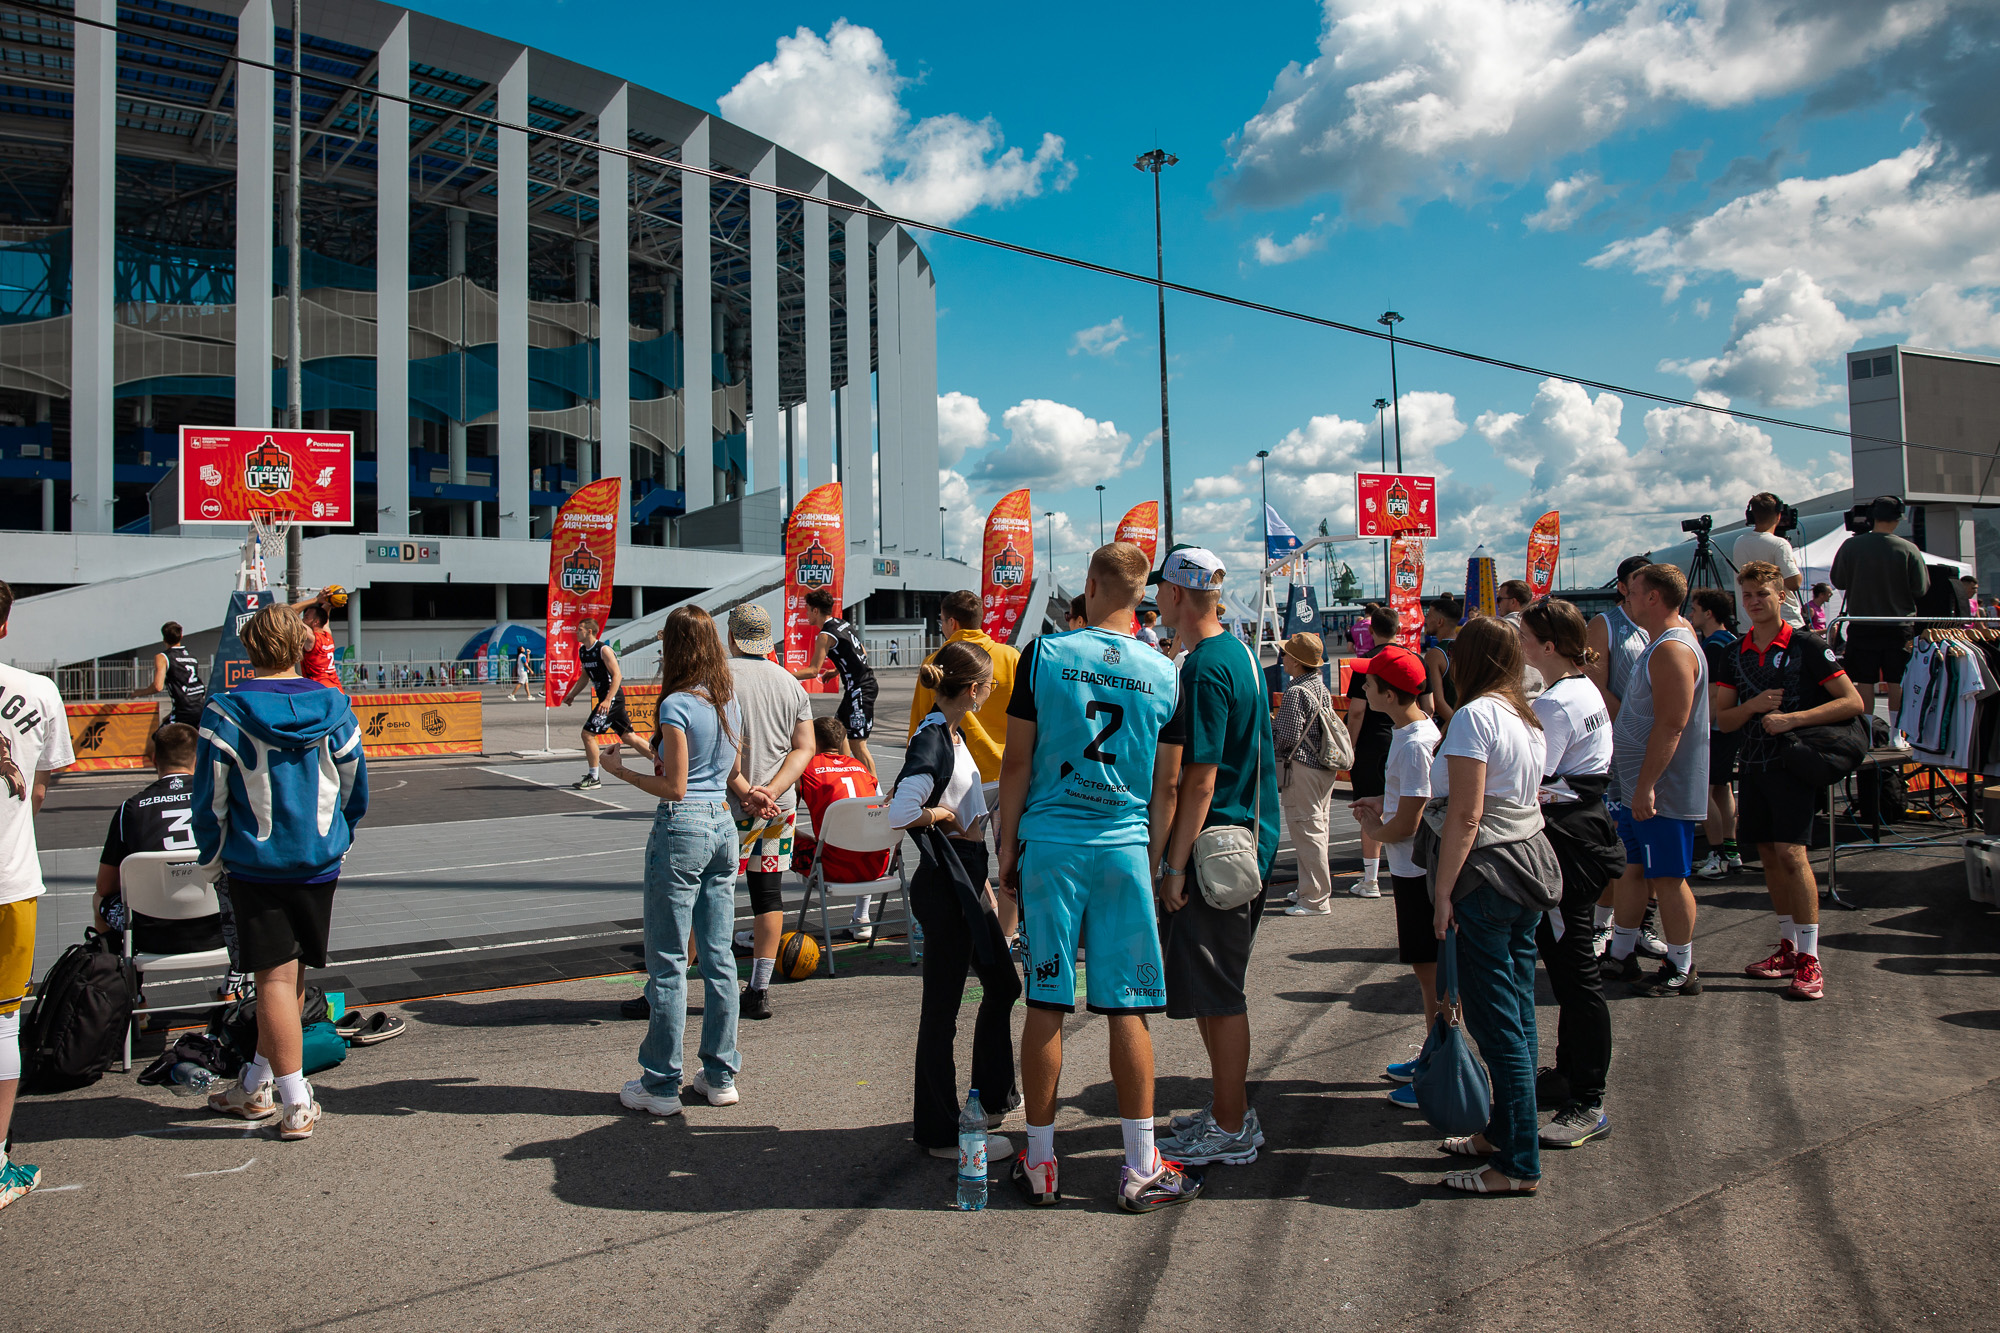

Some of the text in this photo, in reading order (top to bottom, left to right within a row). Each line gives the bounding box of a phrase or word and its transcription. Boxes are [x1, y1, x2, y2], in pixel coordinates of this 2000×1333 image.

[248, 472, 290, 488] OPEN
[1388, 503, 1408, 514] OPEN
[563, 513, 613, 522] ОРАНЖЕВЫЙ
[992, 518, 1029, 526] ОРАНЖЕВЫЙ
[562, 521, 581, 529] МЯЧ
[1122, 527, 1156, 535] ОРАНЖЕВЫЙ
[380, 544, 427, 560] B A D C
[886, 562, 891, 573] D
[563, 573, 599, 588] OPEN
[798, 569, 831, 583] OPEN
[994, 570, 1023, 583] OPEN
[1397, 576, 1415, 586] OPEN
[247, 594, 259, 609] 2
[1360, 633, 1363, 646] 1
[327, 652, 335, 669] 2
[185, 665, 198, 683] 2
[1061, 669, 1154, 695] 52.BASKETBALL
[1083, 700, 1124, 765] 2
[815, 766, 867, 774] 52.BASKETBALL
[840, 776, 857, 798] 1
[162, 808, 197, 851] 3
[1645, 844, 1652, 868] 1
[1125, 988, 1165, 997] SYNERGETIC
